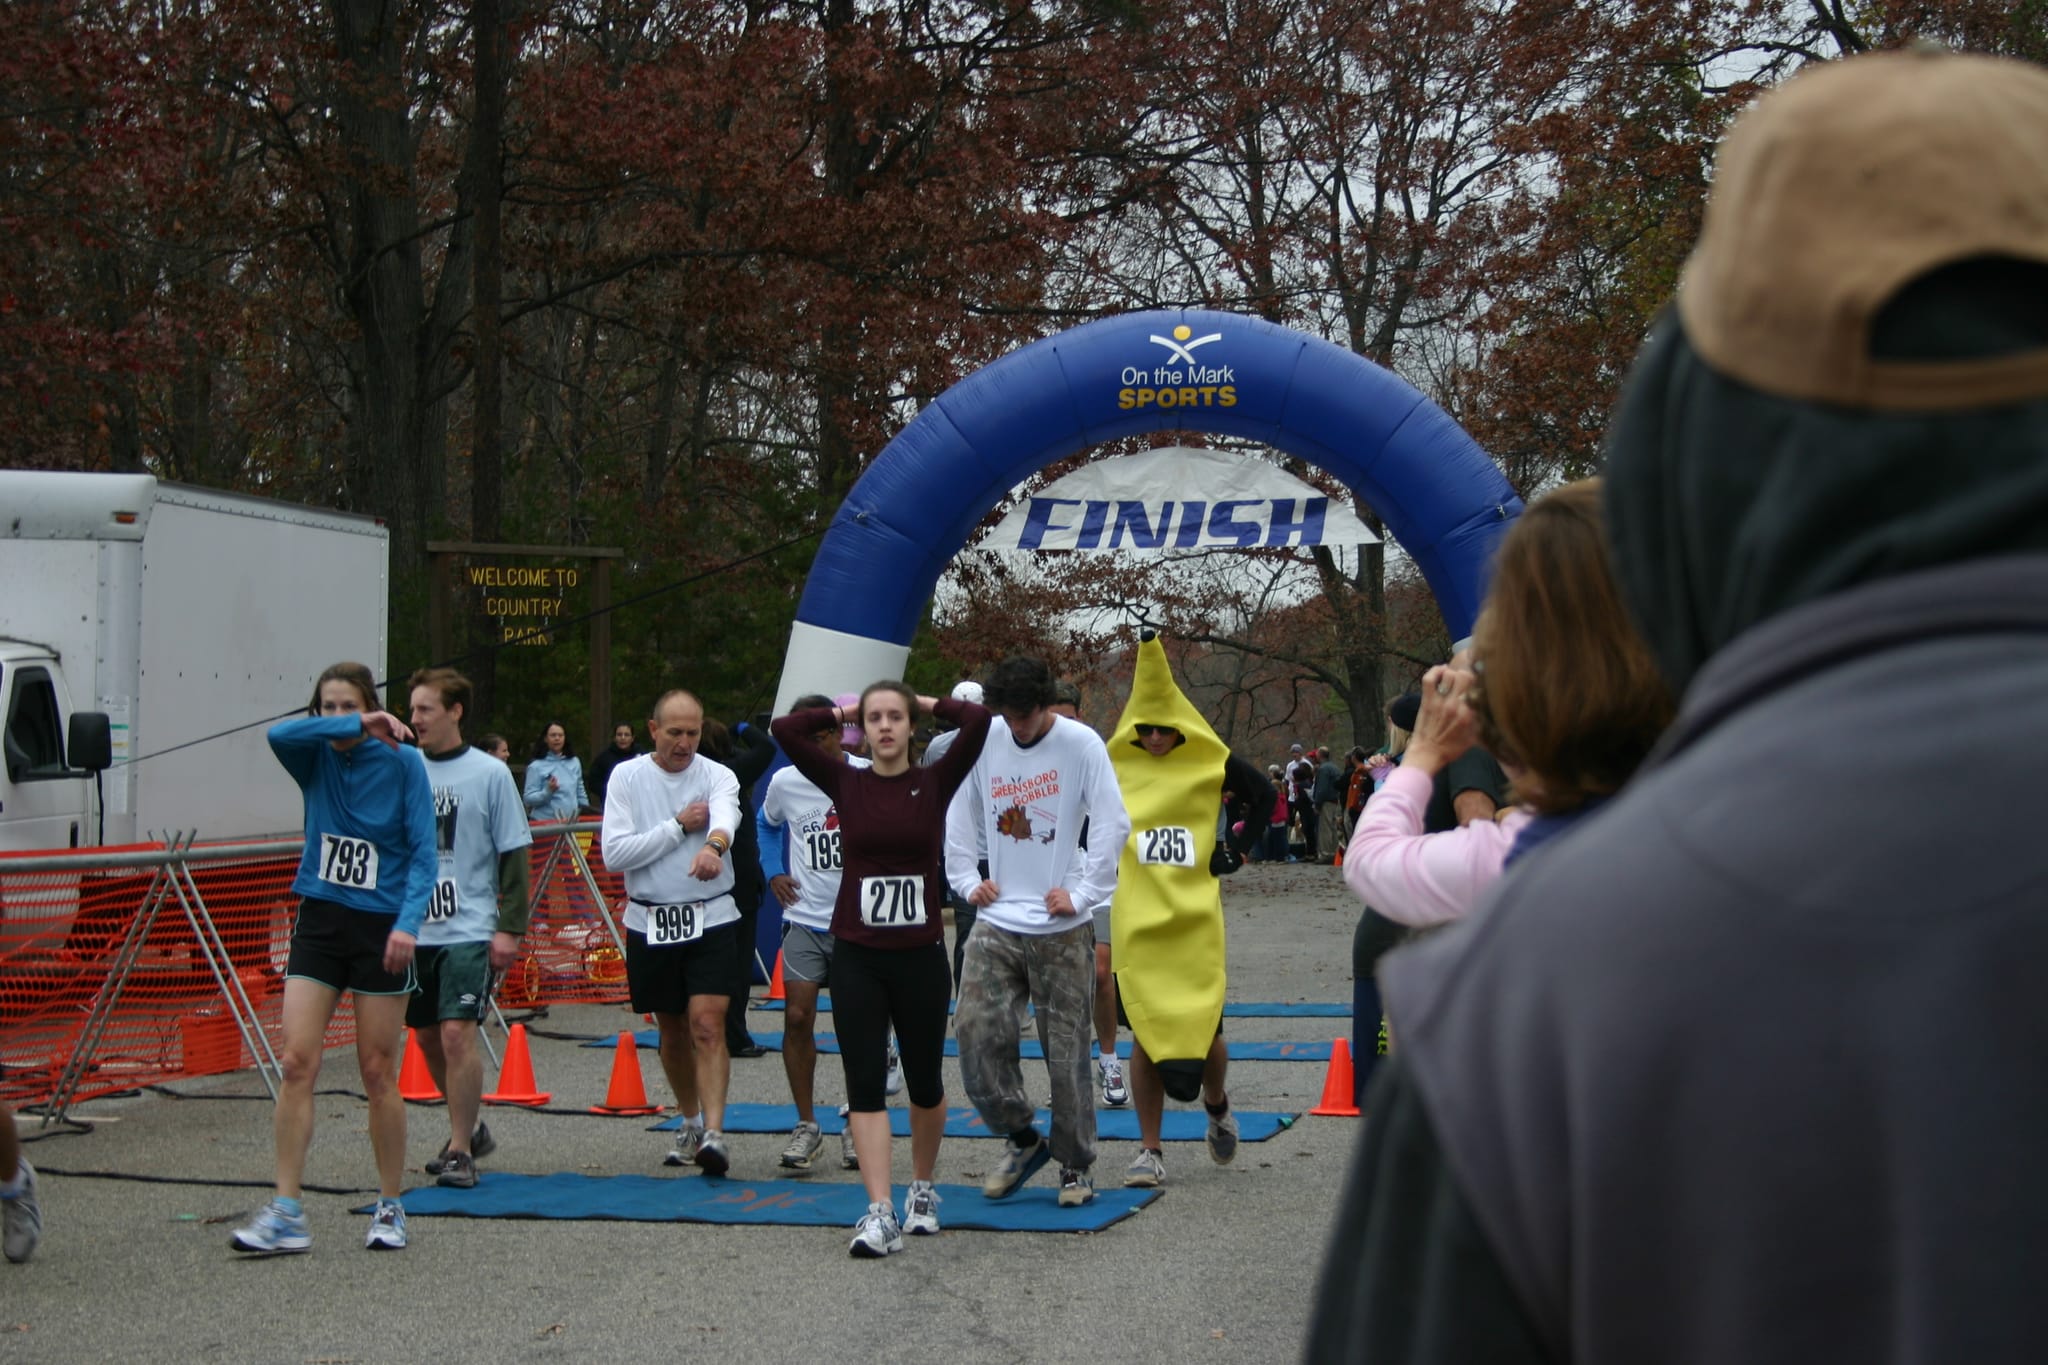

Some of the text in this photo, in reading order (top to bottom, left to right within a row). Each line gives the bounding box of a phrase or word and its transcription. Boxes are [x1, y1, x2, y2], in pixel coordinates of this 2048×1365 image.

[1121, 364, 1235, 386] On the Mark
[1118, 385, 1237, 410] SPORTS
[1017, 496, 1329, 549] FINISH
[470, 567, 577, 588] WELCOME TO
[487, 598, 561, 616] COUNTRY
[504, 627, 549, 646] PARK
[991, 769, 1058, 799] GREENSBORO
[1013, 783, 1060, 806] GOBBLER
[325, 836, 370, 885] 793
[807, 832, 843, 870] 193
[1145, 828, 1186, 863] 235
[424, 880, 457, 920] 09
[870, 879, 917, 924] 270
[655, 905, 695, 942] 999
